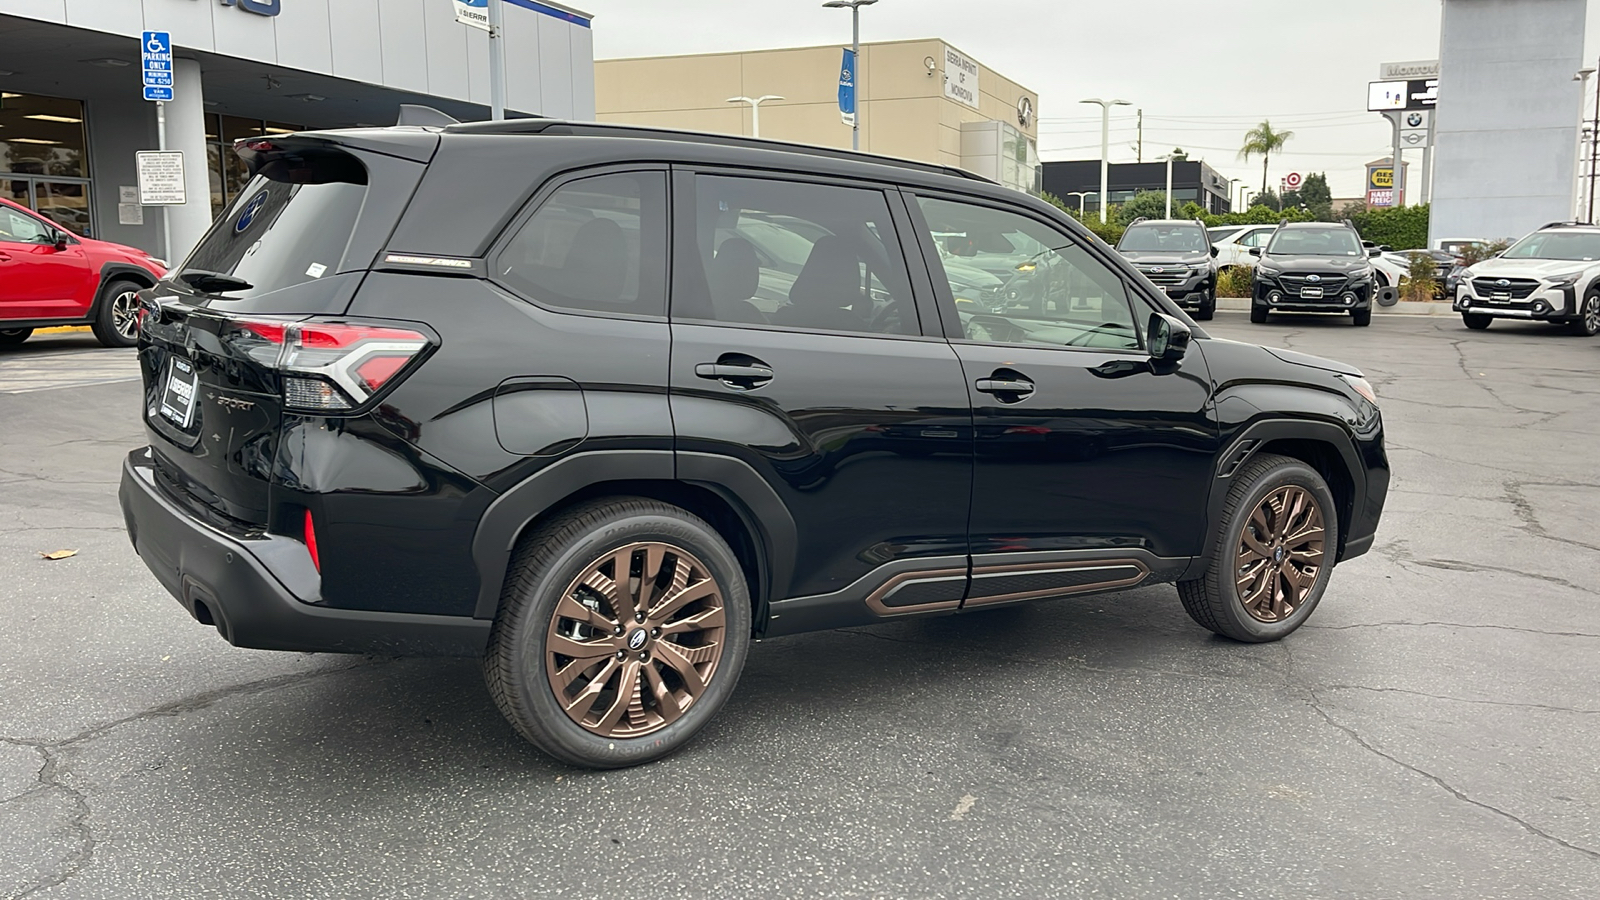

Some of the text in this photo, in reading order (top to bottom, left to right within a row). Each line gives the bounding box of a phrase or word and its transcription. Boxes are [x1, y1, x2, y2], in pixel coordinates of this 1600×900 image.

[463, 10, 487, 22] SIERRA
[144, 52, 170, 61] PARKING
[946, 50, 962, 67] SIERRA
[149, 61, 166, 69] ONLY
[1387, 63, 1439, 77] Monrovi
[959, 72, 966, 84] OF
[951, 83, 973, 103] MONROVIA
[217, 396, 255, 411] SPORT
